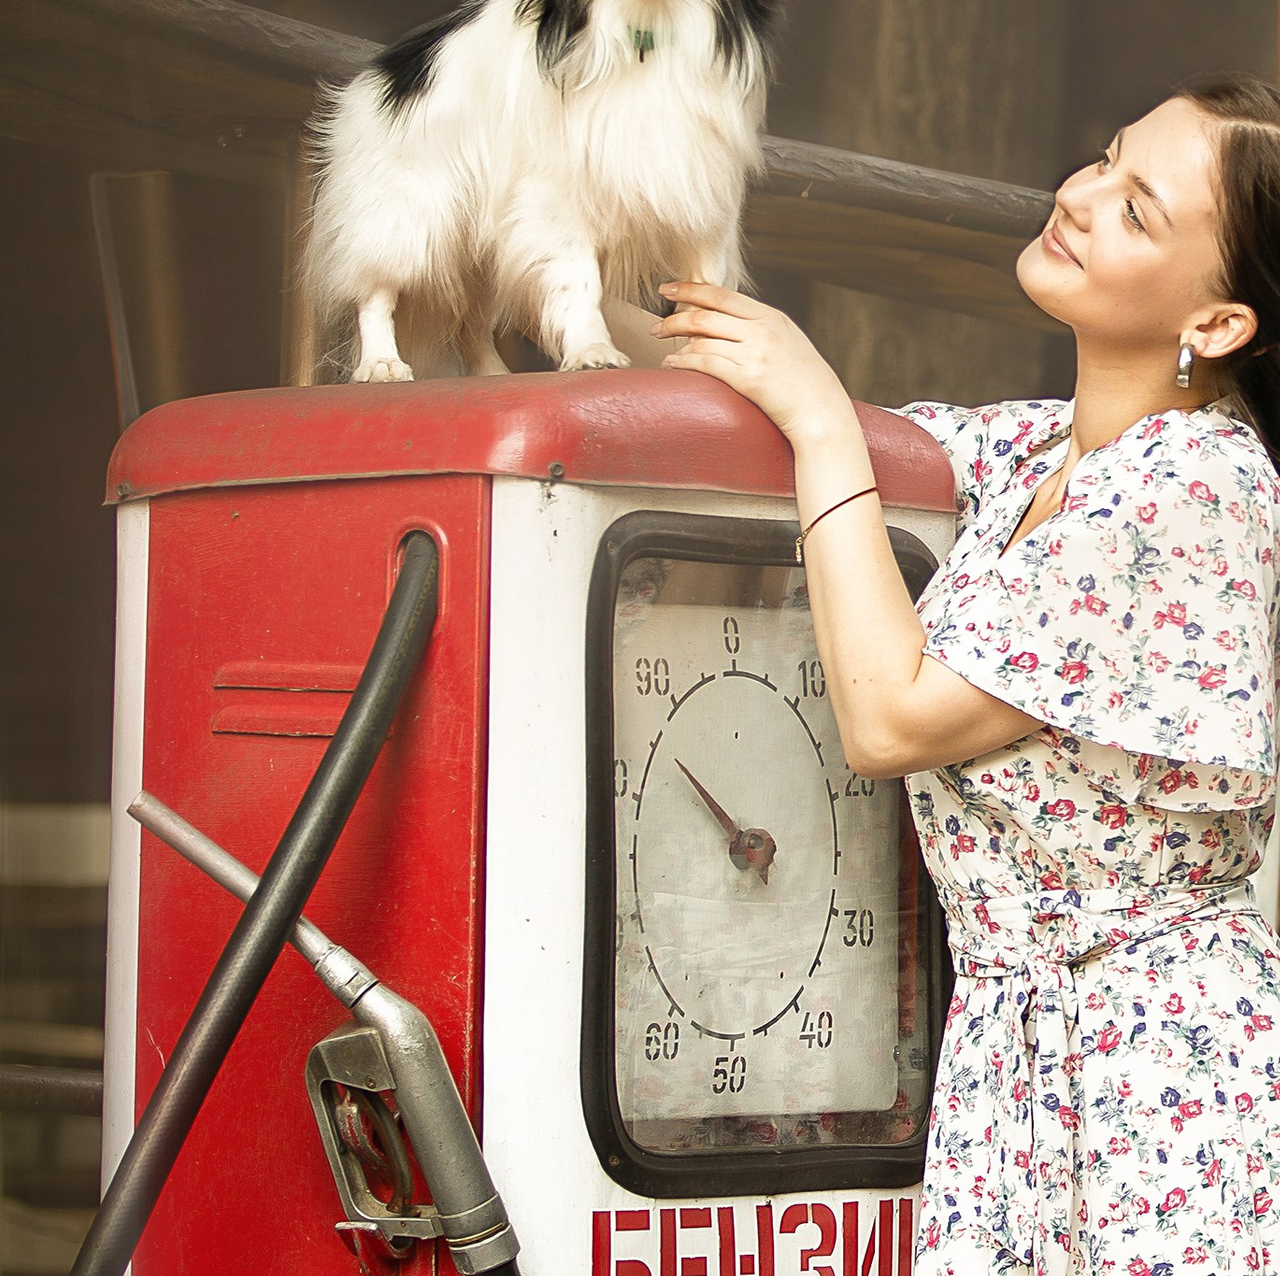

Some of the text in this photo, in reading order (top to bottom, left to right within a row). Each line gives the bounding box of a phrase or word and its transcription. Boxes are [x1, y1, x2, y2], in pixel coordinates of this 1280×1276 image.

[723, 616, 740, 654] 0
[635, 657, 670, 696] 90
[798, 660, 826, 698] 10
[843, 909, 874, 947] 30
[645, 1022, 680, 1061] 60
[800, 1011, 833, 1049] 40
[713, 1056, 747, 1094] 50
